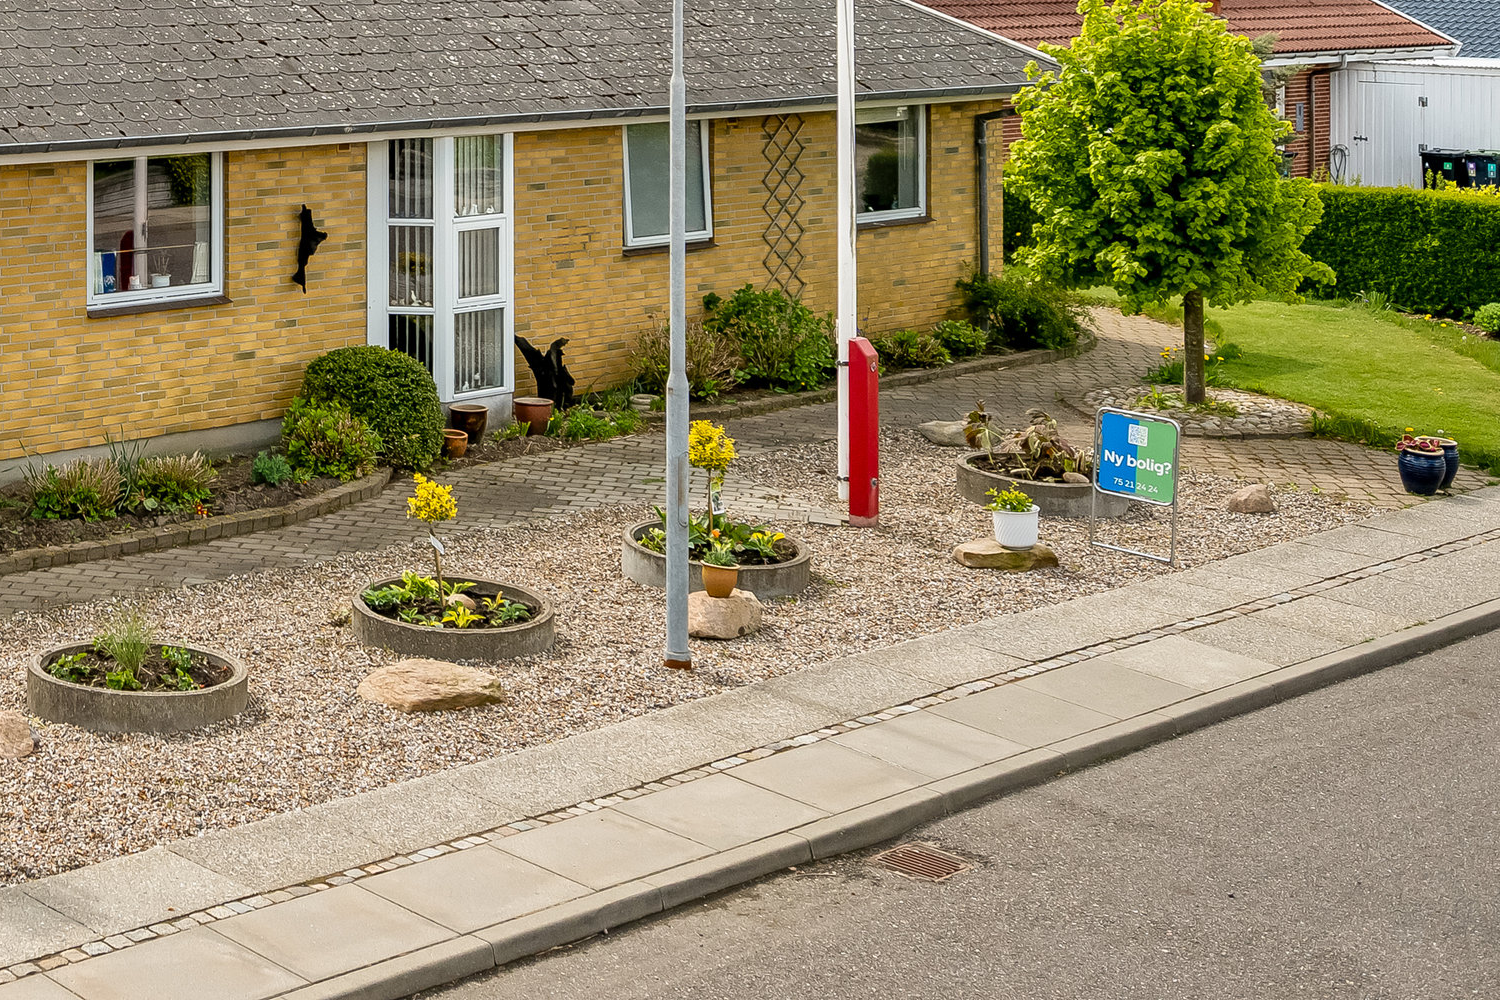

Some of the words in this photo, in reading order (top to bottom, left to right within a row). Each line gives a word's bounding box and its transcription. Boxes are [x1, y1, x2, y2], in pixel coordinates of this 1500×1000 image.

[1104, 449, 1124, 467] Ny
[1126, 454, 1172, 476] bolig?
[1113, 477, 1124, 486] 75
[1124, 479, 1135, 489] 21
[1136, 482, 1147, 491] 24
[1147, 485, 1158, 494] 24
